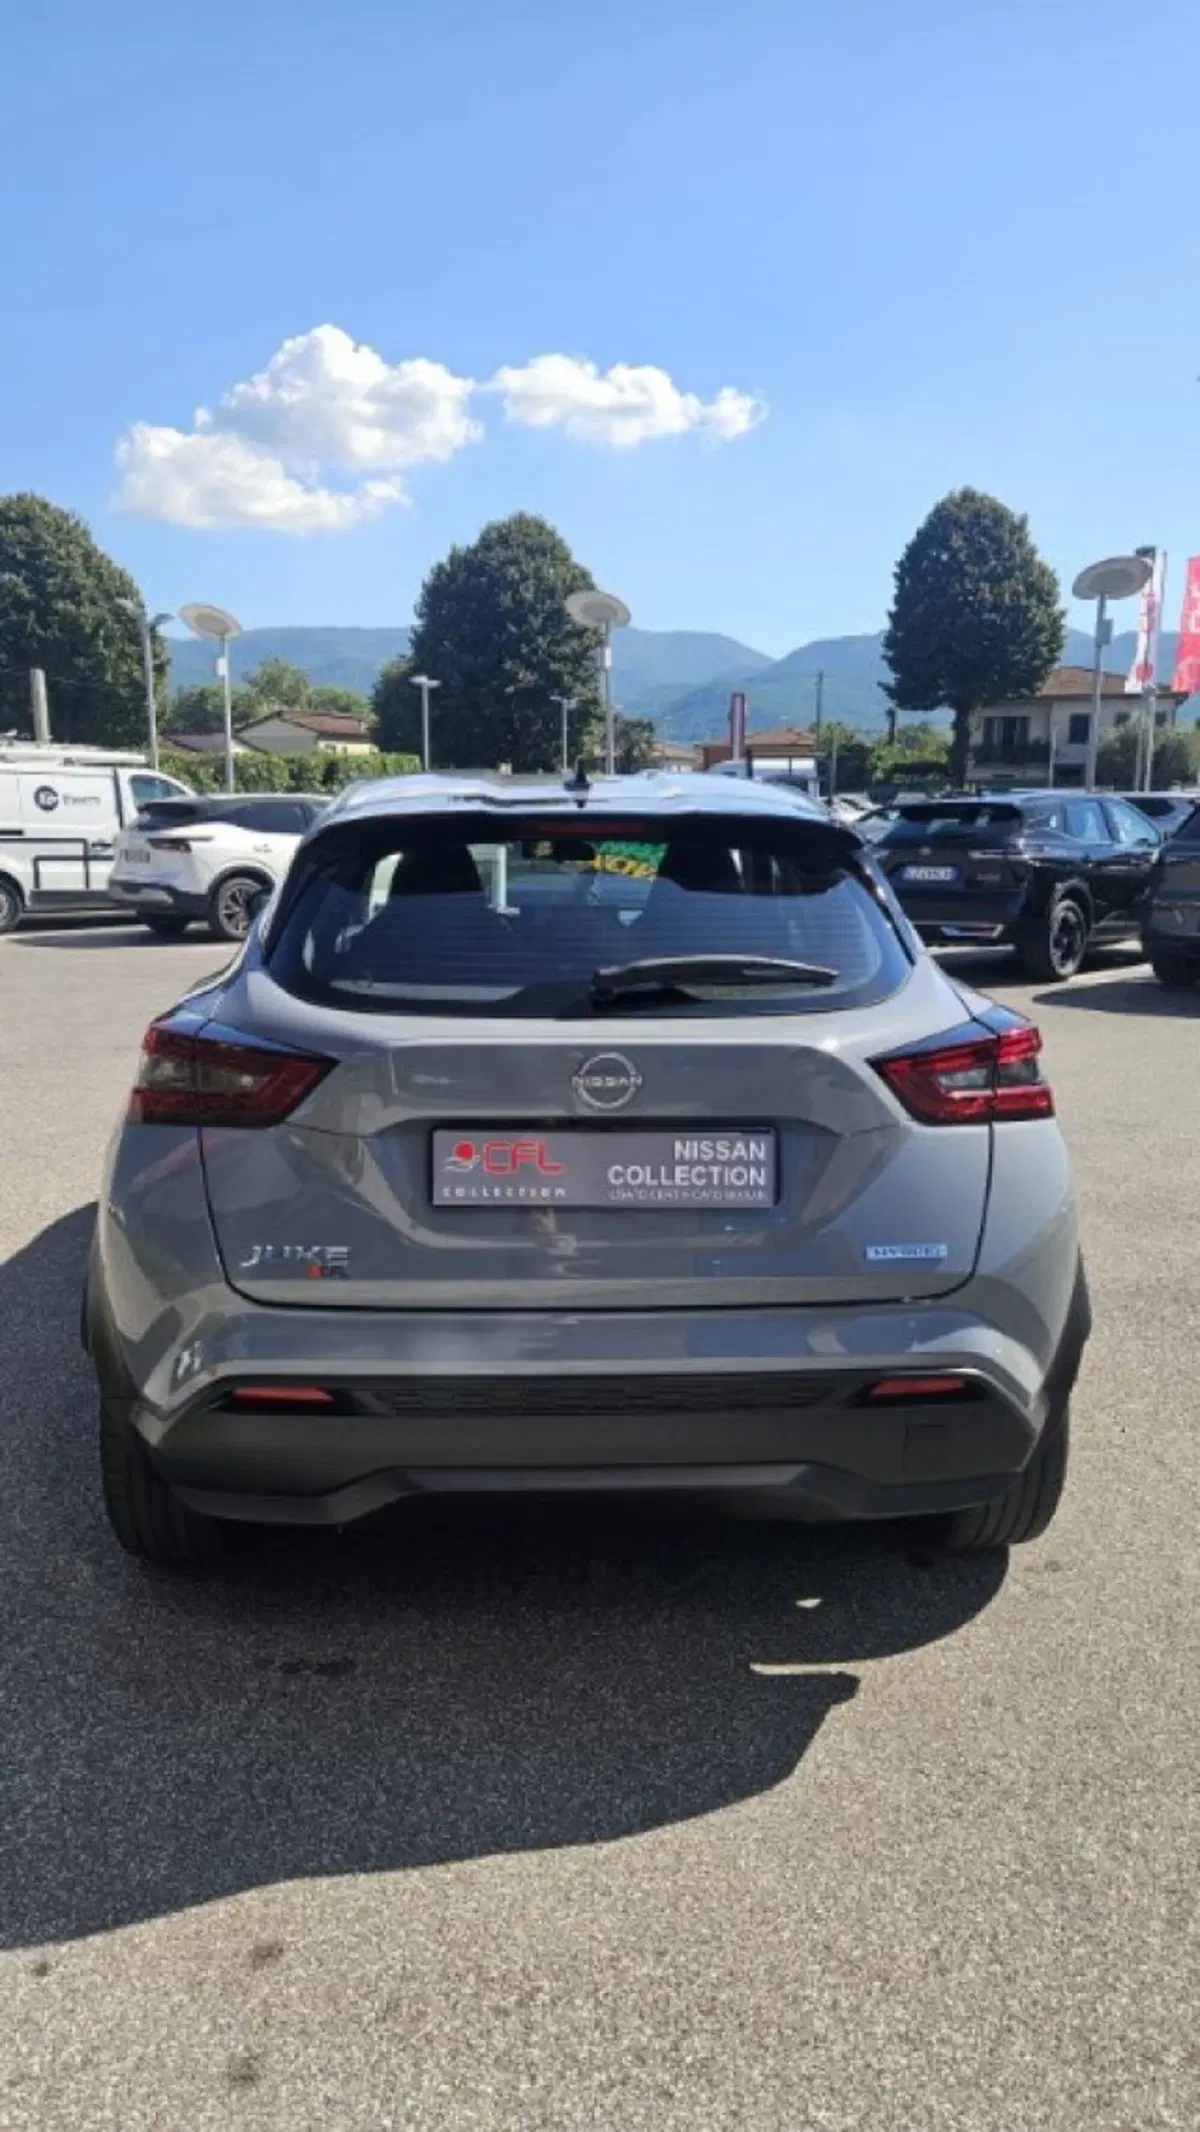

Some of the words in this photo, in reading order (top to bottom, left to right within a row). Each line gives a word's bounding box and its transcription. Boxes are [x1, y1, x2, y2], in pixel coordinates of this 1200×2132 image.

[571, 1075, 642, 1088] NISSAN
[483, 1140, 565, 1175] CFL
[673, 1139, 766, 1161] NISSAN
[607, 1164, 766, 1186] COLLECTION
